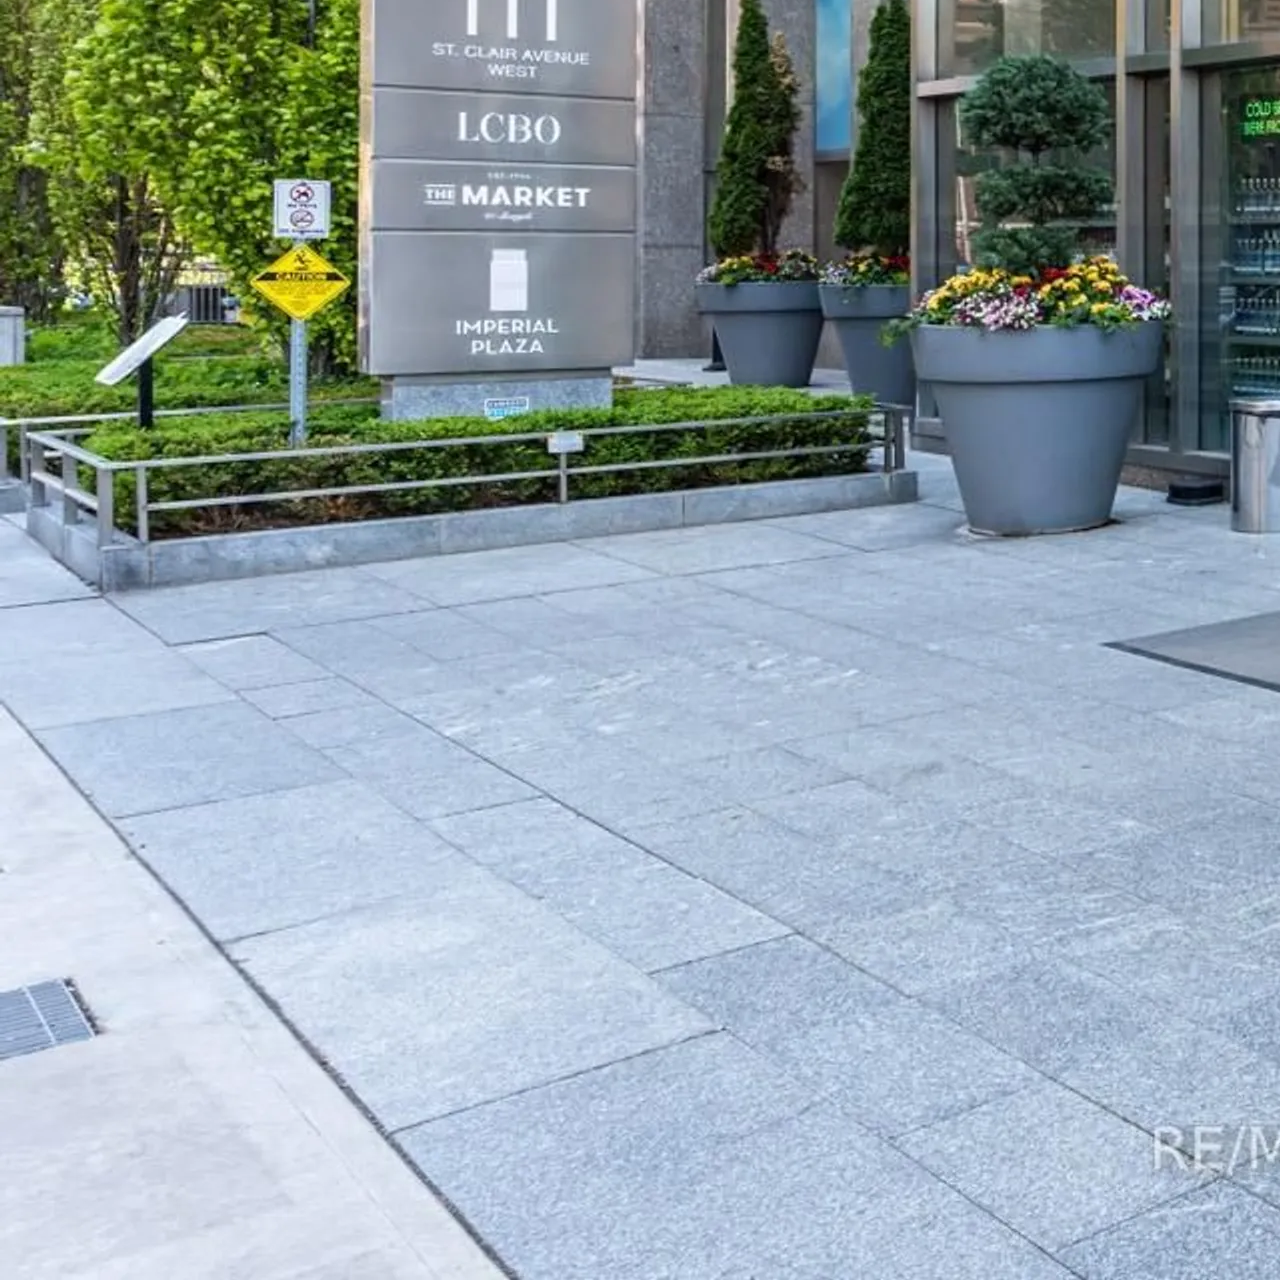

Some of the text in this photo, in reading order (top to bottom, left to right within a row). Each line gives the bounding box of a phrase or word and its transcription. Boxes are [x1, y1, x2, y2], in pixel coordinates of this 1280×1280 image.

[432, 42, 591, 66] ST. CLAIR AVENUE
[486, 63, 538, 79] WEST
[1245, 101, 1271, 118] COLD
[457, 111, 562, 146] LCBO
[425, 184, 591, 207] THE MARKET
[456, 318, 560, 335] IMPERIAL
[471, 339, 545, 356] PLAZA
